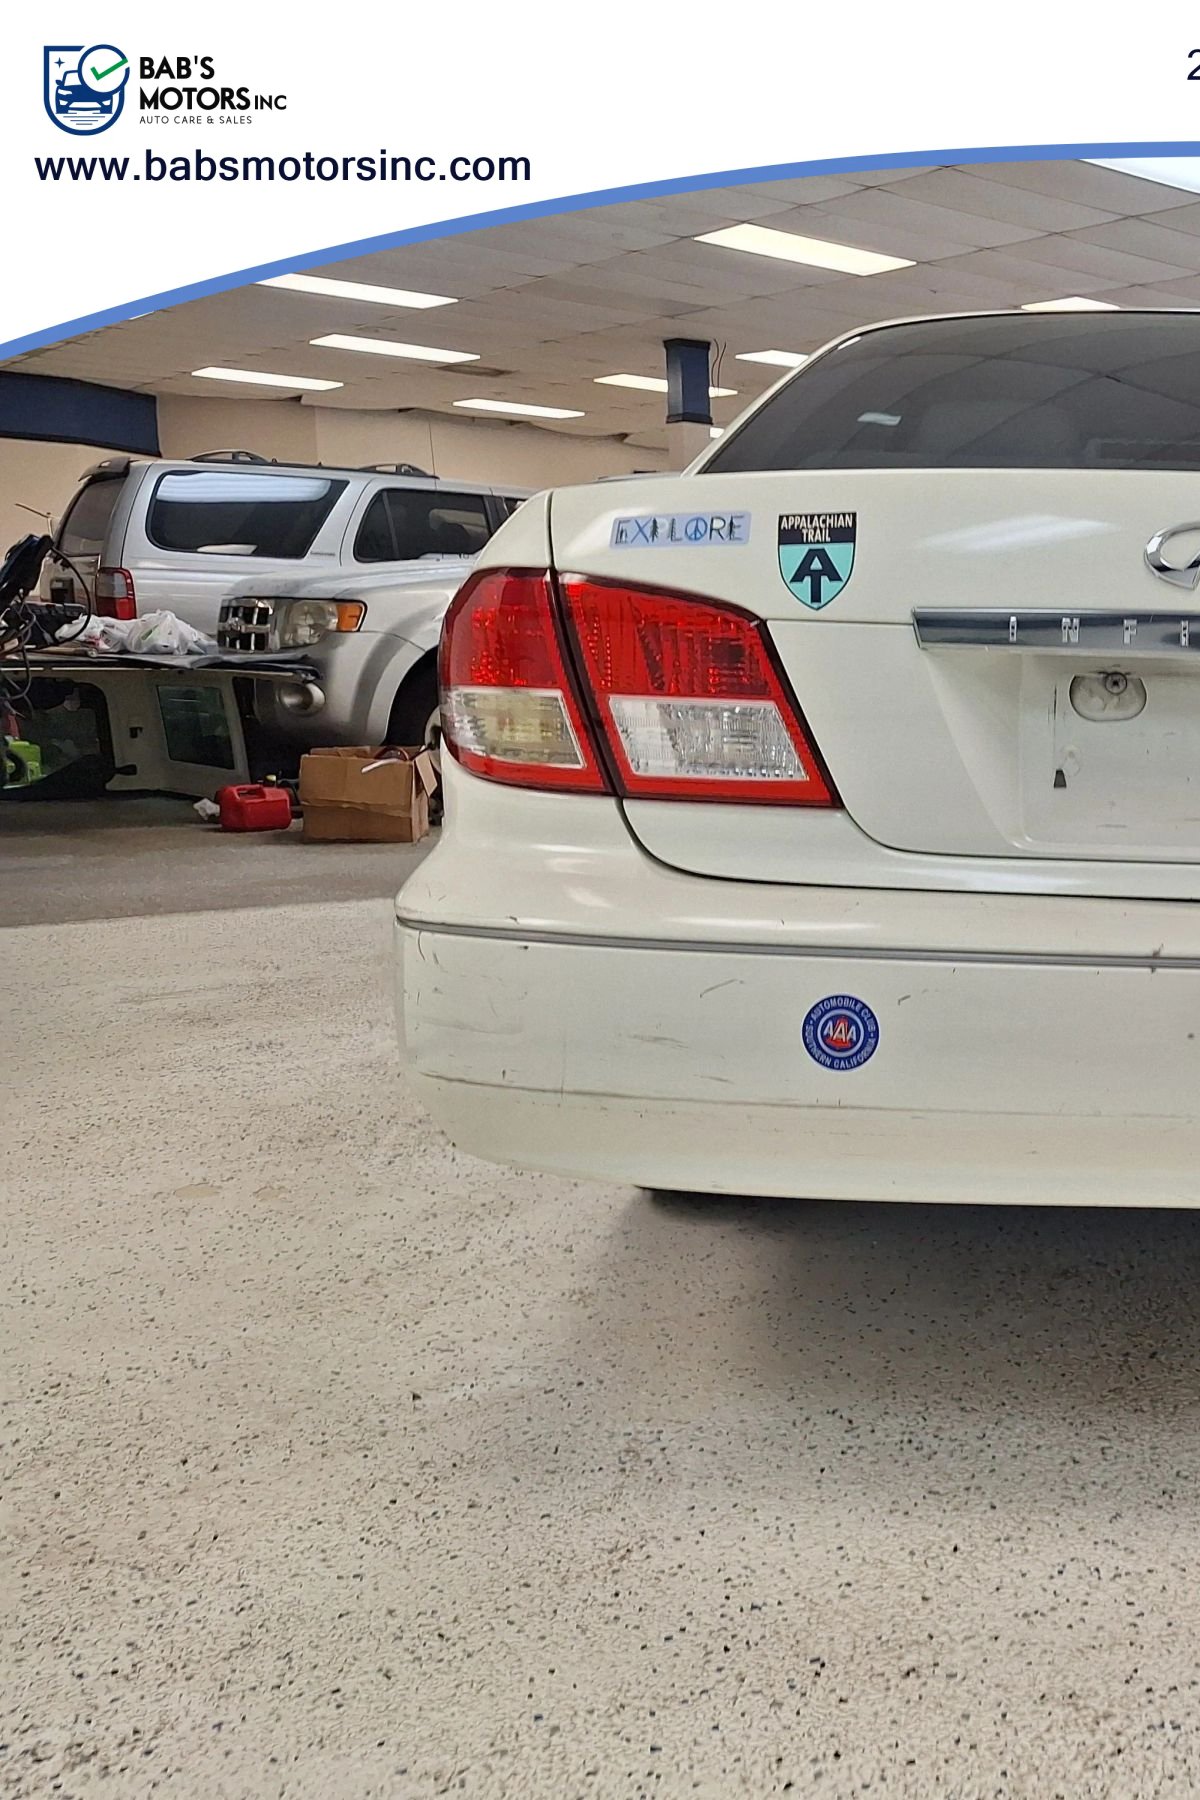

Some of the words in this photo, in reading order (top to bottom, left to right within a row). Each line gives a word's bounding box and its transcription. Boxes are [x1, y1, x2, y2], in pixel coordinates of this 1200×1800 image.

[615, 514, 745, 545] EXPLORE
[780, 514, 854, 530] APPALACHIAN
[801, 528, 832, 543] TRAIL
[810, 996, 863, 1021] AUTOMOBILE
[823, 1019, 857, 1043] AAA
